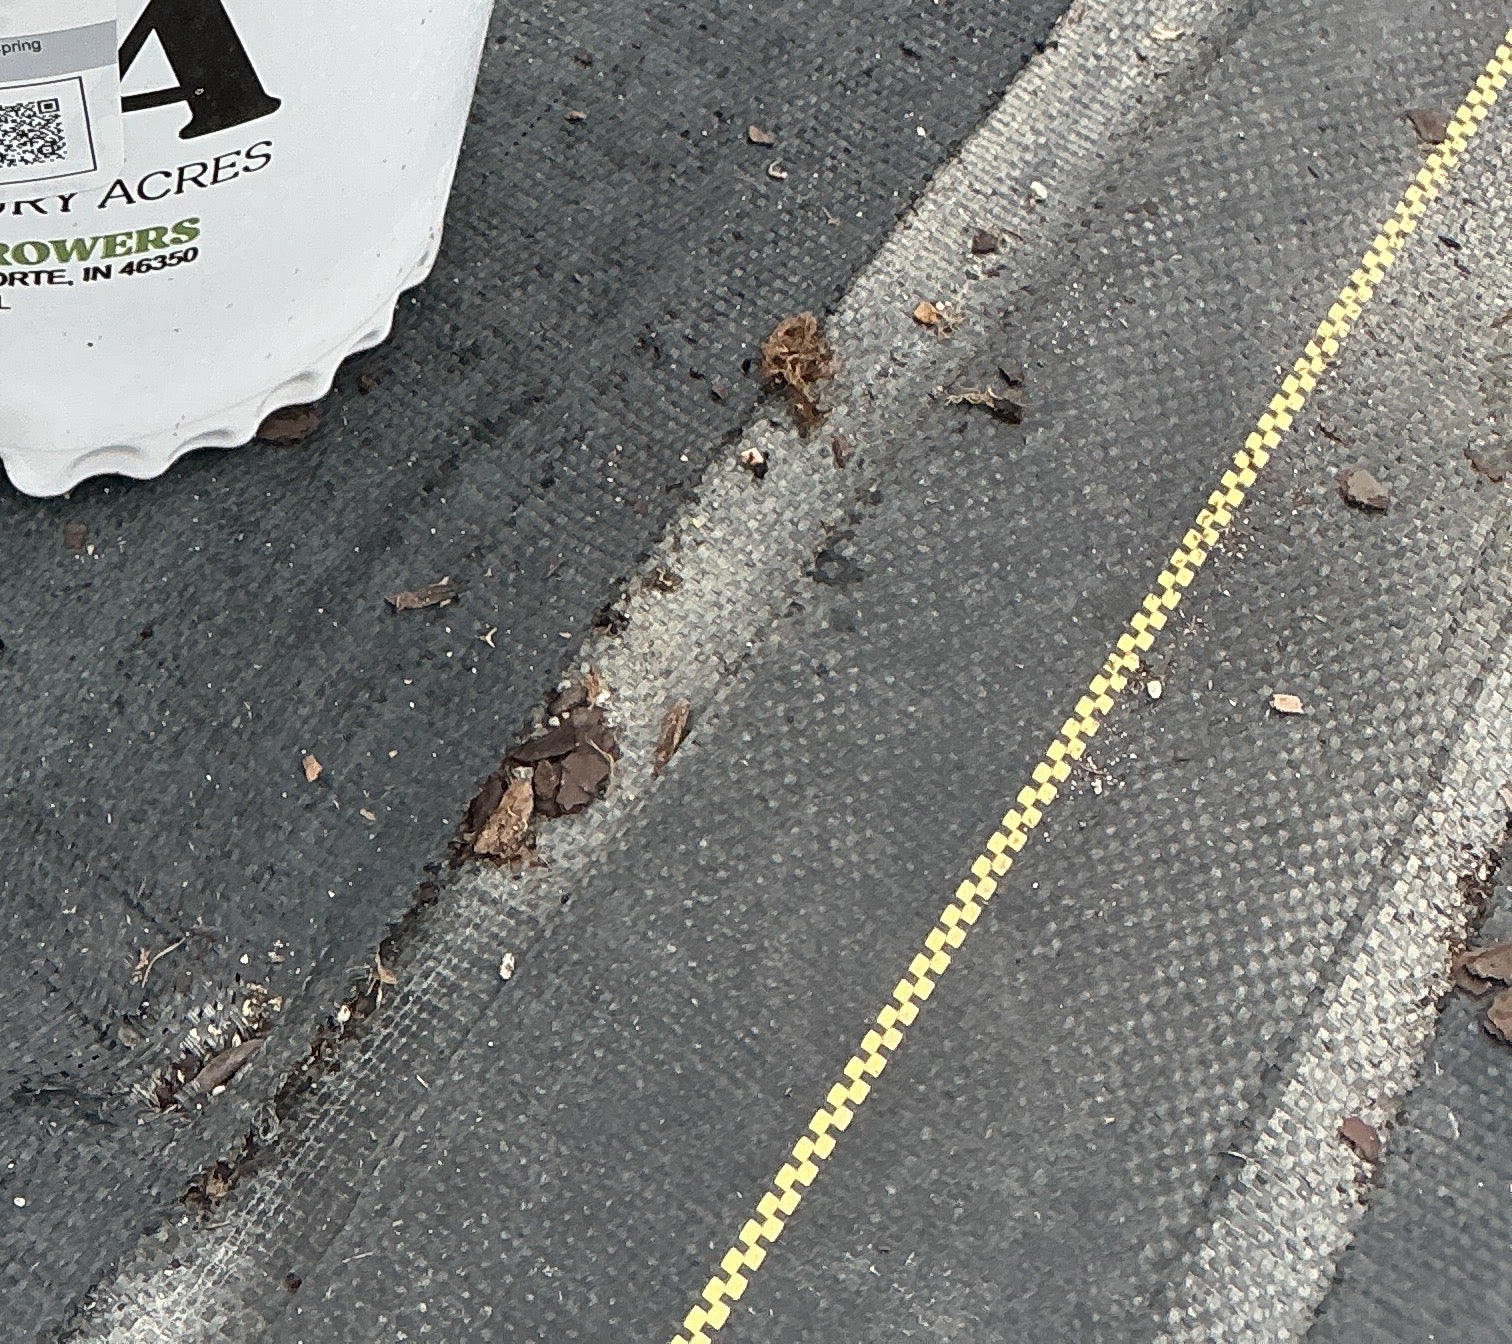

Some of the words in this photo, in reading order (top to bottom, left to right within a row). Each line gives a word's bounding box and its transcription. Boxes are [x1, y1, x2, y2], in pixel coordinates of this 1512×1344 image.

[97, 140, 274, 211] ACRES
[82, 265, 113, 283] IN
[118, 246, 201, 277] 46350
